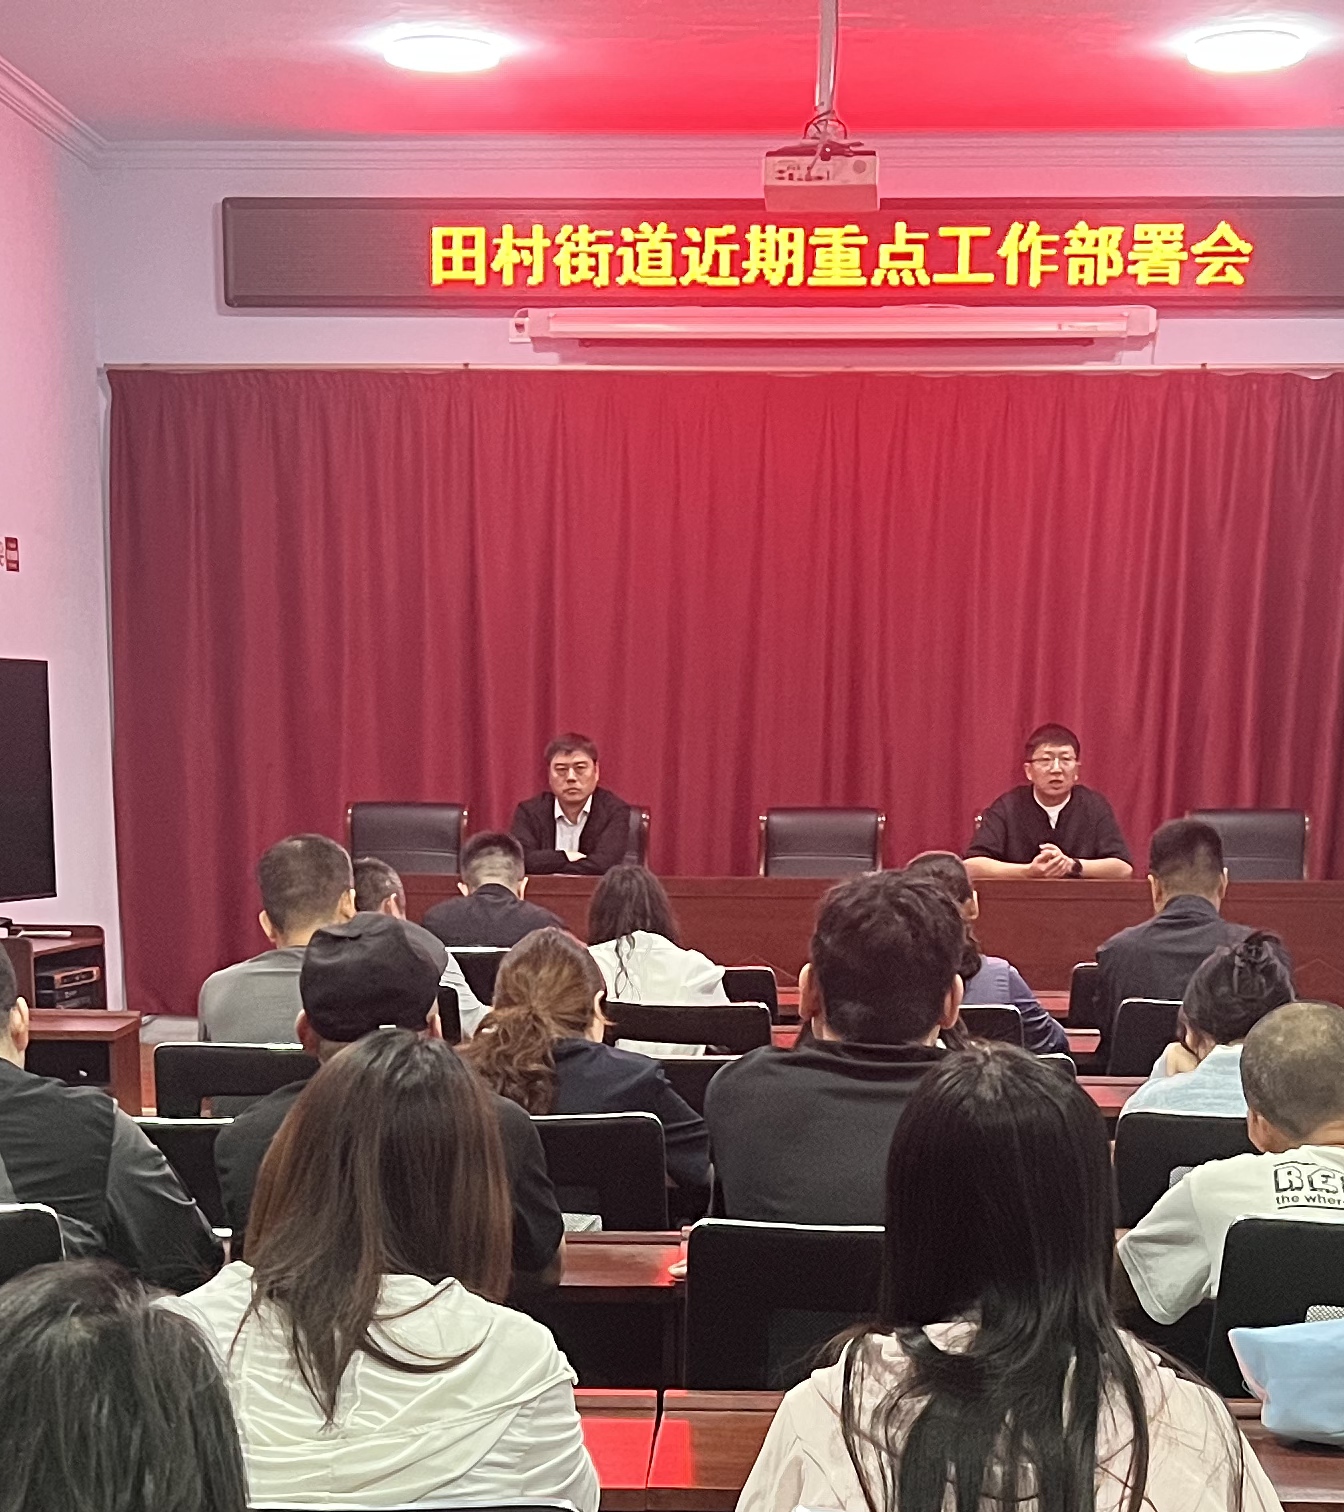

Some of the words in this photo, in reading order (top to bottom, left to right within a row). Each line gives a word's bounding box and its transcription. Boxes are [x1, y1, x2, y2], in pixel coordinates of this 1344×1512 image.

[430, 220, 1254, 288] 田村街道近期重点工作部署会
[1275, 1194, 1300, 1205] the
